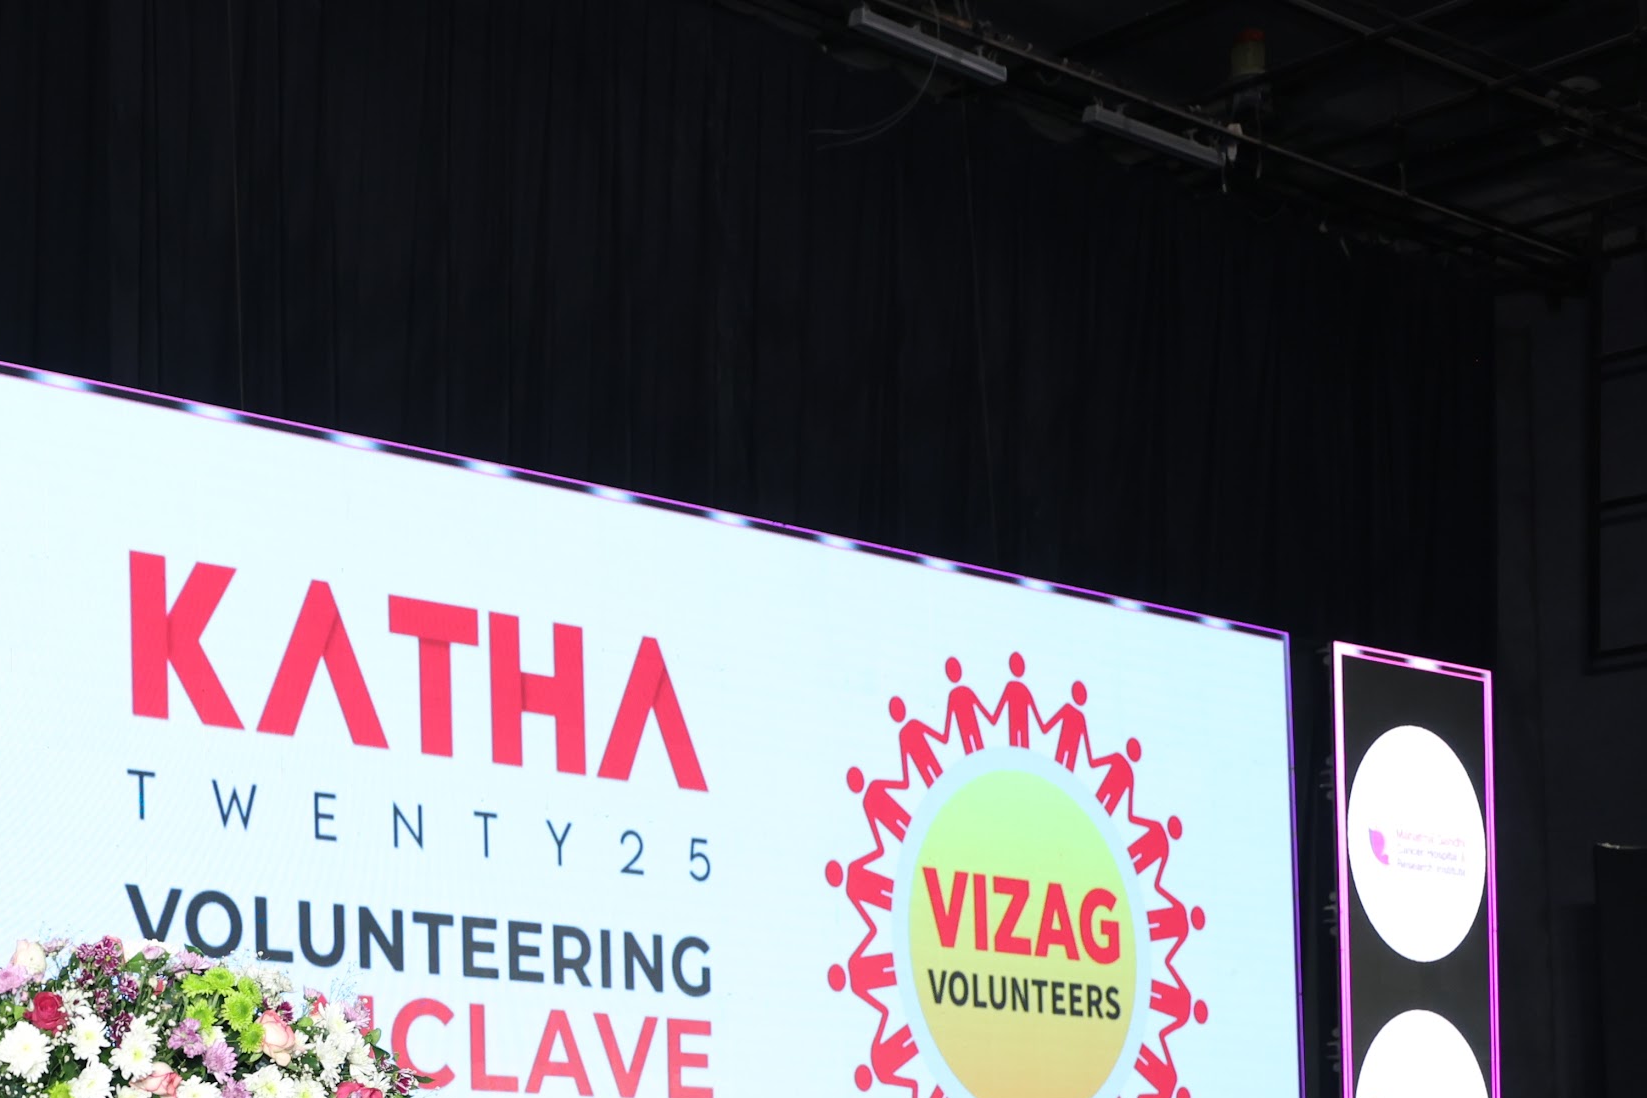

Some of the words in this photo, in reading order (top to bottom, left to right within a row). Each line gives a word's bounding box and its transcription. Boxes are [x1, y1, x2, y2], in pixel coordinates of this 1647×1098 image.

[129, 550, 709, 792] KATHA
[125, 884, 712, 998] VOLUNTEERING
[922, 866, 1121, 965] VIZAG
[927, 968, 1121, 1020] VOLUNTEERS
